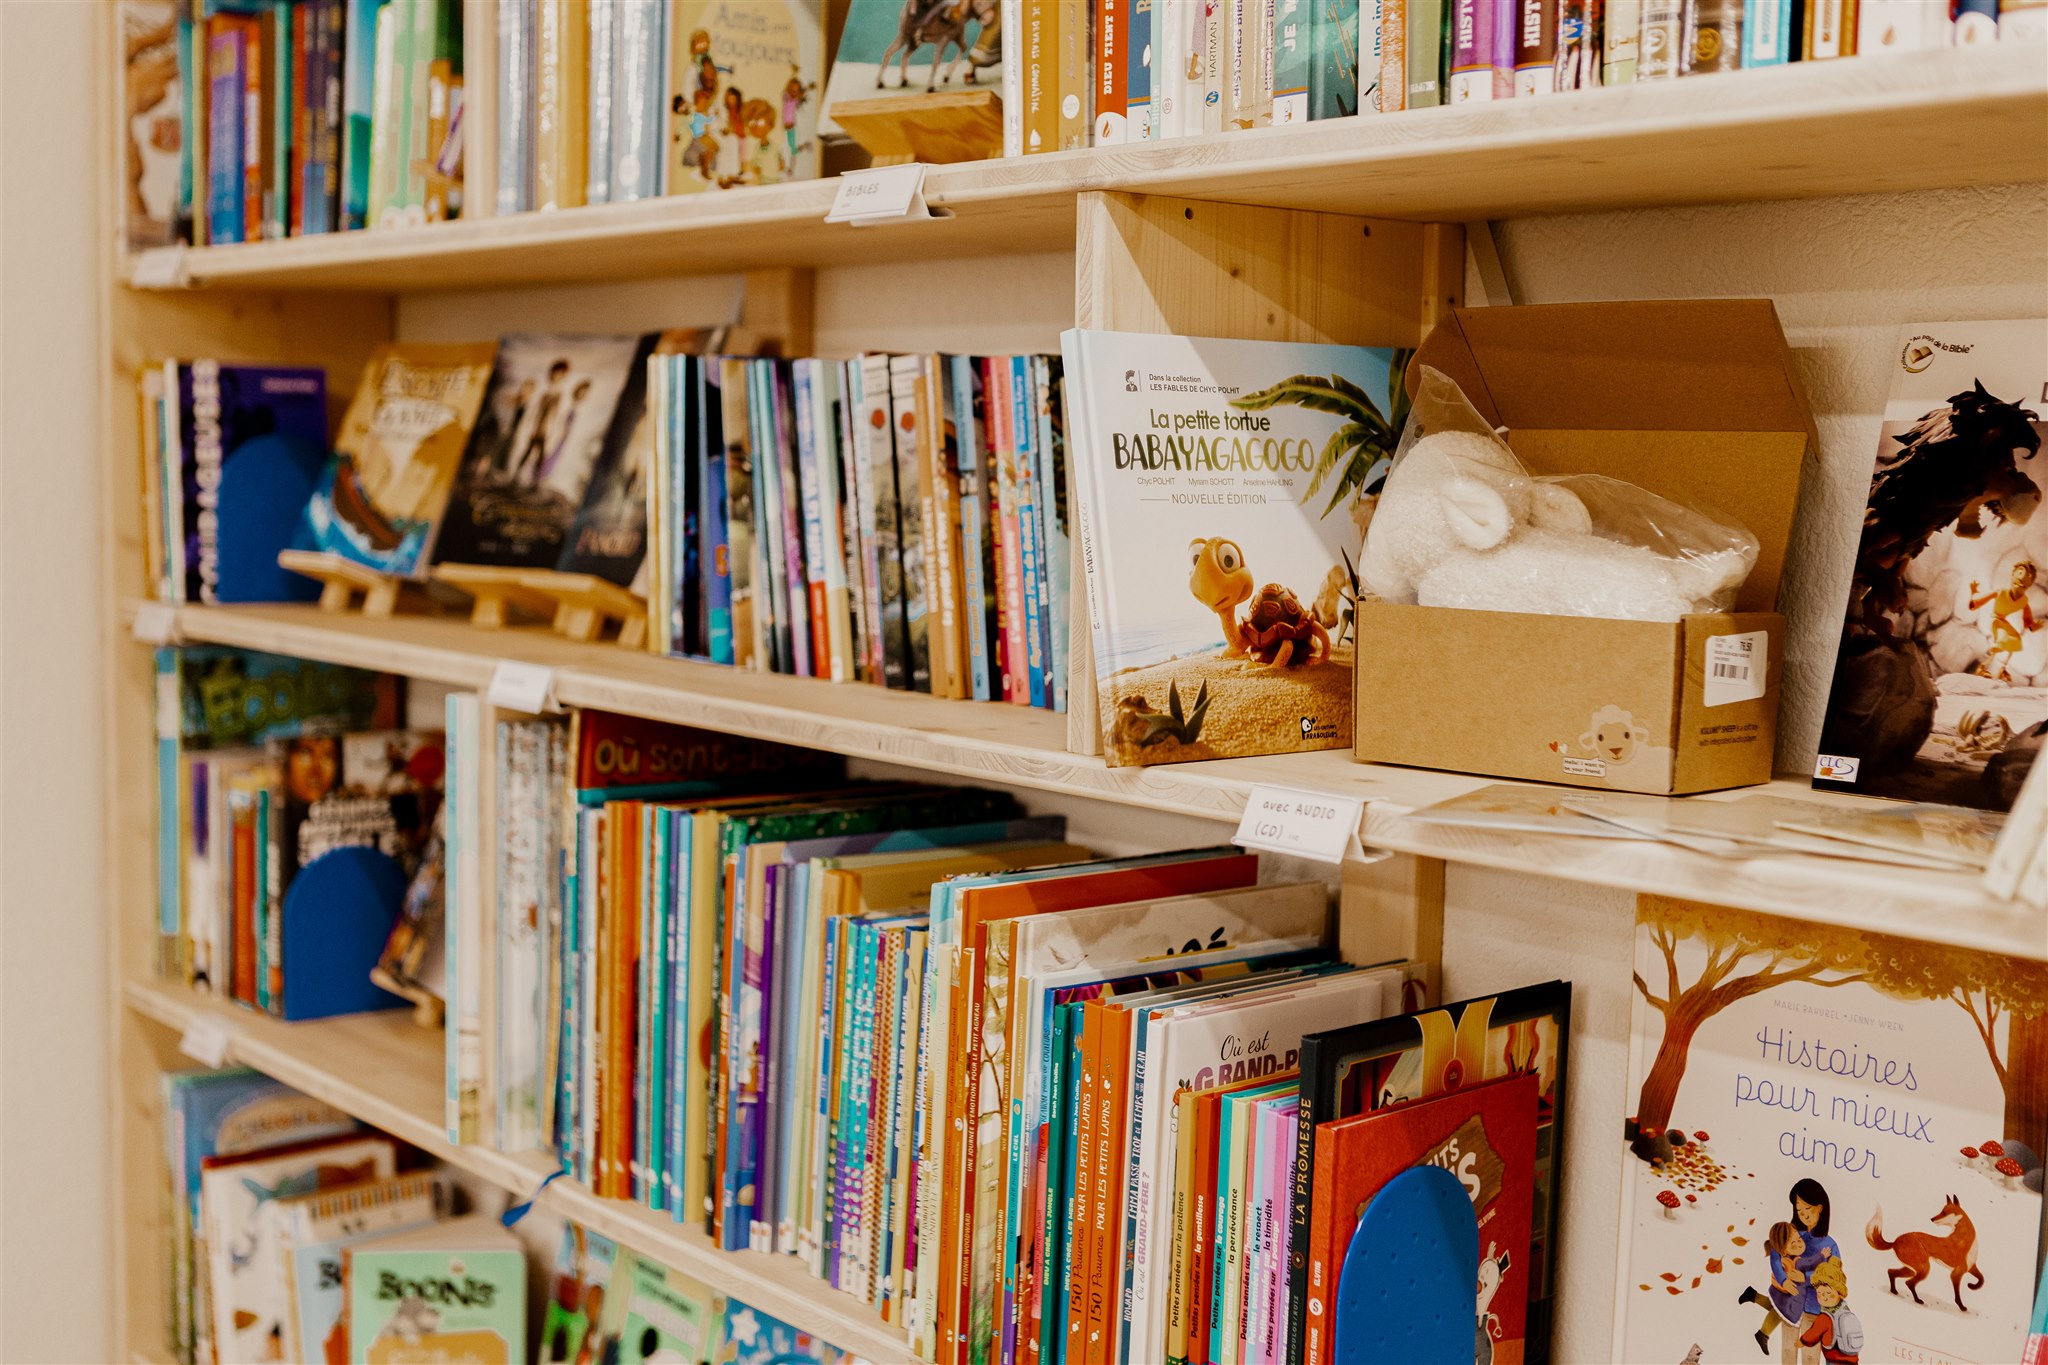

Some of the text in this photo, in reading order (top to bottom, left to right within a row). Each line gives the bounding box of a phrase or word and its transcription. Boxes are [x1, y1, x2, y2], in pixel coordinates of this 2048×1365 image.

[1209, 21, 1217, 78] HARTMAN
[1284, 23, 1297, 52] JE
[1103, 15, 1114, 95] DIEU TIENT
[846, 183, 879, 197] BIBLES
[1922, 335, 1974, 354] pays de la Bible"
[1163, 384, 1188, 392] FABLES
[1199, 386, 1217, 394] CHYC
[1218, 386, 1240, 395] POLHIT
[1165, 374, 1171, 382] la
[1172, 375, 1202, 383] collection
[1150, 408, 1271, 434] La petite tortue
[1112, 432, 1315, 472] BABAYAGAGOGO
[1209, 477, 1235, 486] SCHOTT
[1172, 492, 1267, 505] NOUVELLE ÉDITION
[1820, 756, 1844, 768] CLC
[1263, 801, 1336, 820] avec AUDIO
[1255, 820, 1284, 840] (CD)
[1774, 999, 1904, 1033] MARIE JENNY WREN
[972, 1053, 978, 1061] LE
[1221, 1031, 1270, 1060] Où est
[1757, 1026, 1917, 1091] Histoires
[968, 1082, 977, 1125] D'ÉMOTIONS
[1134, 1095, 1143, 1124] TEMPS
[1735, 1074, 1934, 1143] pour mieux
[967, 1126, 975, 1157] JOURNÉE
[1132, 1135, 1141, 1158] TROP
[1779, 1127, 1880, 1178] aimer
[1012, 1153, 1018, 1162] LE
[1295, 1097, 1311, 1225] LA PROMESSE
[1130, 1162, 1140, 1187] PASSE
[1072, 1093, 1091, 1313] 150 Psaumes POUR LES PETITS LAPINS
[1090, 1099, 1110, 1322] 150 Psaumes POUR LES PETITS LAPINS
[1128, 1190, 1139, 1220] EMMA
[1176, 1191, 1184, 1232] patience
[1195, 1195, 1204, 1242] gentillesse
[1216, 1196, 1225, 1234] courage
[1263, 1198, 1272, 1238] timidité
[996, 1209, 1004, 1250] WOODWARD
[1047, 1219, 1052, 1229] LA
[1138, 1182, 1149, 1265] GRAND-PÈRE
[1228, 1188, 1238, 1252] persévérance
[1254, 1206, 1262, 1241] respect
[1284, 1278, 1290, 1287] le
[1288, 1161, 1297, 1234] responsabilités
[961, 1213, 971, 1287] ANTONIA WOODWARD
[1175, 1233, 1182, 1242] la
[1194, 1244, 1201, 1253] la
[1215, 1235, 1222, 1244] le
[1253, 1244, 1261, 1253] le
[1263, 1241, 1271, 1250] la
[1270, 1220, 1280, 1260] partage
[1227, 1255, 1235, 1264] la
[1269, 1261, 1277, 1270] le
[1136, 1269, 1145, 1283] est
[1173, 1260, 1182, 1295] pensées
[1192, 1270, 1201, 1306] pensées
[1213, 1262, 1221, 1297] pensées
[1242, 1271, 1250, 1307] pensées
[1249, 1273, 1258, 1309] pensées
[1261, 1270, 1270, 1308] pensées
[1124, 1288, 1132, 1322] HOWARD
[1135, 1286, 1145, 1300] Où
[1226, 1285, 1234, 1321] pensées
[1267, 1288, 1276, 1324] pensées
[1172, 1296, 1181, 1327] Petites
[1191, 1307, 1199, 1339] Petites
[1211, 1299, 1220, 1330] Petites
[1240, 1309, 1248, 1340] Petites
[1258, 1310, 1267, 1344] Petites
[1223, 1325, 1231, 1356] Petites
[1248, 1312, 1257, 1344] Petites
[1265, 1326, 1274, 1357] Petites
[1894, 1346, 1912, 1361] LES
